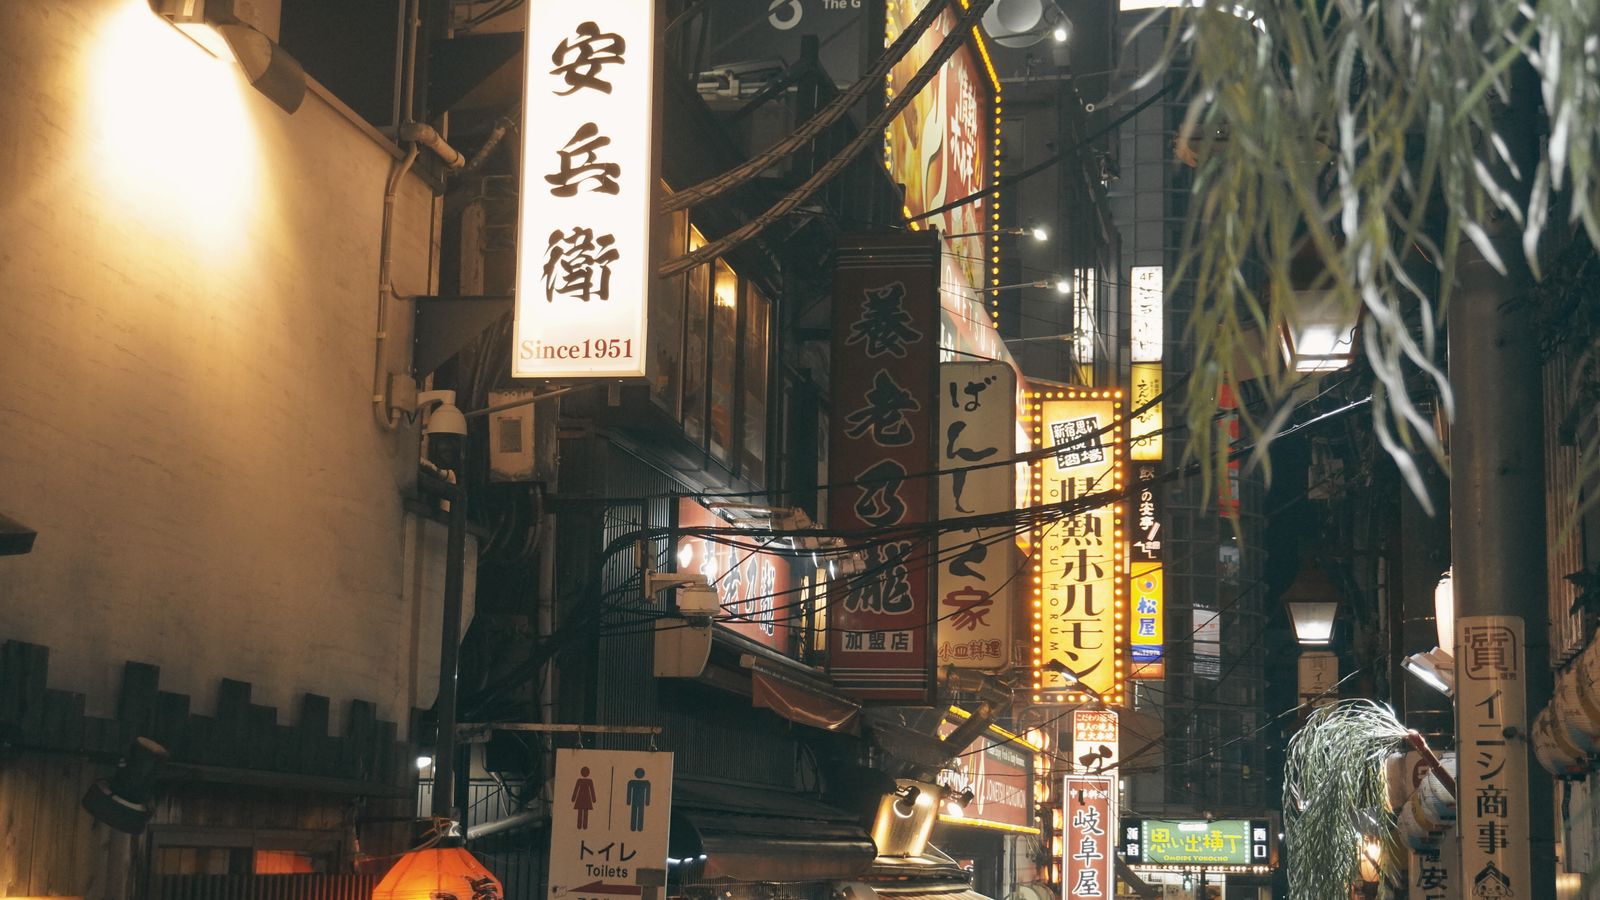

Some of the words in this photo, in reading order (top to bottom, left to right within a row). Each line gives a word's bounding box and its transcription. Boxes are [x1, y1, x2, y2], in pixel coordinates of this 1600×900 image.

[823, 0, 847, 9] The
[541, 21, 627, 303] 安兵衛
[519, 338, 634, 361] Since1951
[1059, 449, 1103, 467] 酒場
[1137, 596, 1157, 636] 松屋
[845, 631, 911, 652] 加盟店
[1049, 582, 1060, 684] HORUMN
[938, 639, 1003, 661] 小皿料理
[1471, 632, 1509, 672] 質
[1475, 689, 1510, 855] イニシ商事
[579, 840, 637, 862] トイレ
[1073, 806, 1104, 898] 岐阜屋
[1126, 827, 1139, 857] 新宿
[1150, 828, 1243, 854] 思い出横丁
[1253, 828, 1267, 858] 西口
[585, 864, 628, 879] Toilets
